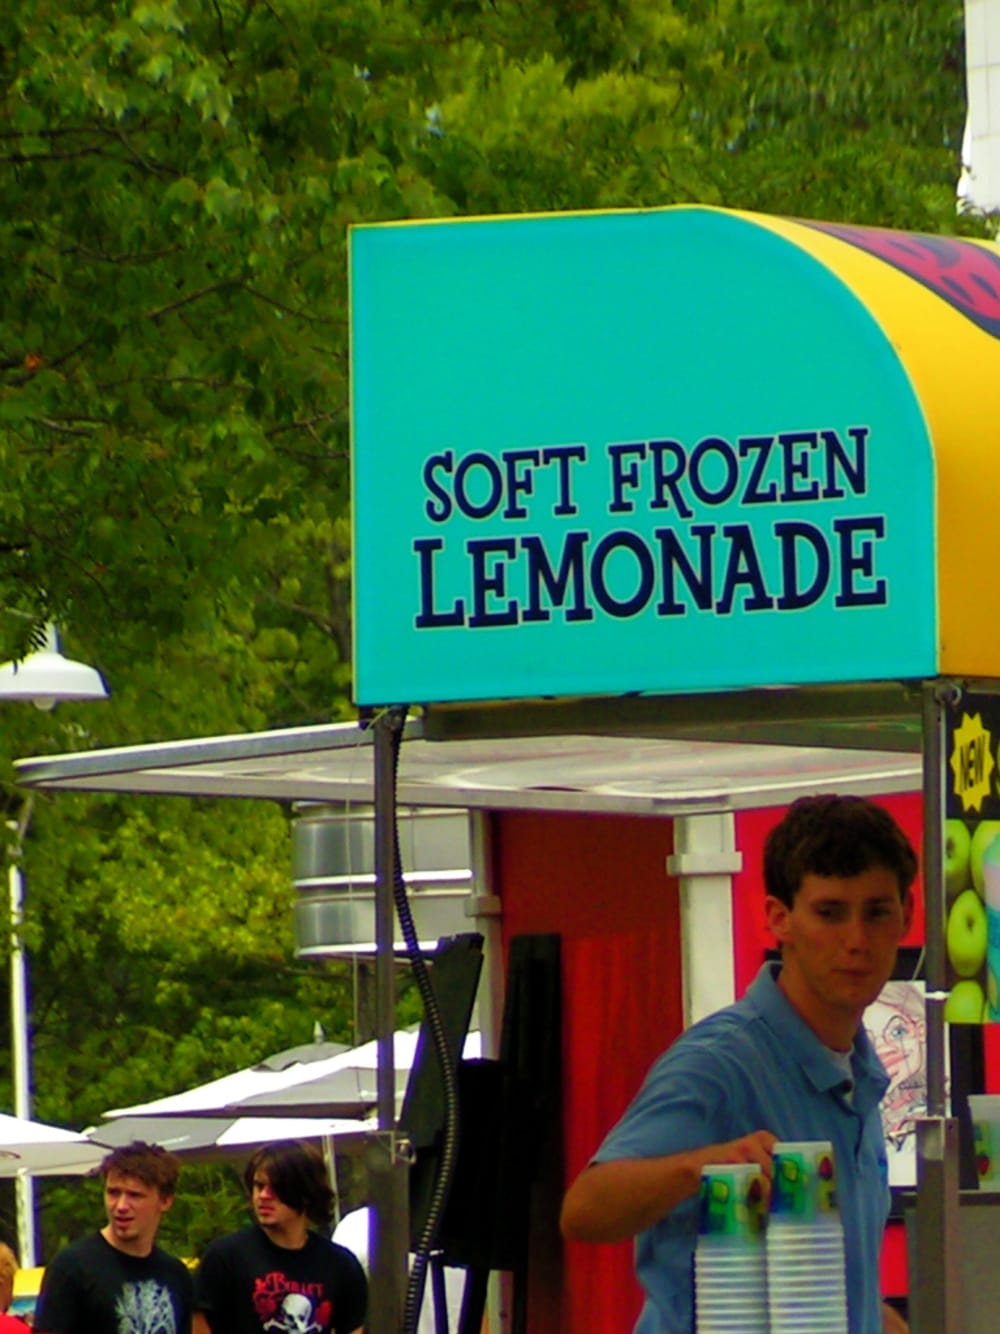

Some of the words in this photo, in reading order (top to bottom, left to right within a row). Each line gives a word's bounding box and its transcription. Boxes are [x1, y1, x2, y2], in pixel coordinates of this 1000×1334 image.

[423, 446, 587, 521] SOFT
[607, 428, 869, 518] FROZEN
[413, 516, 887, 628] LEMONADE
[959, 733, 986, 792] NEW
